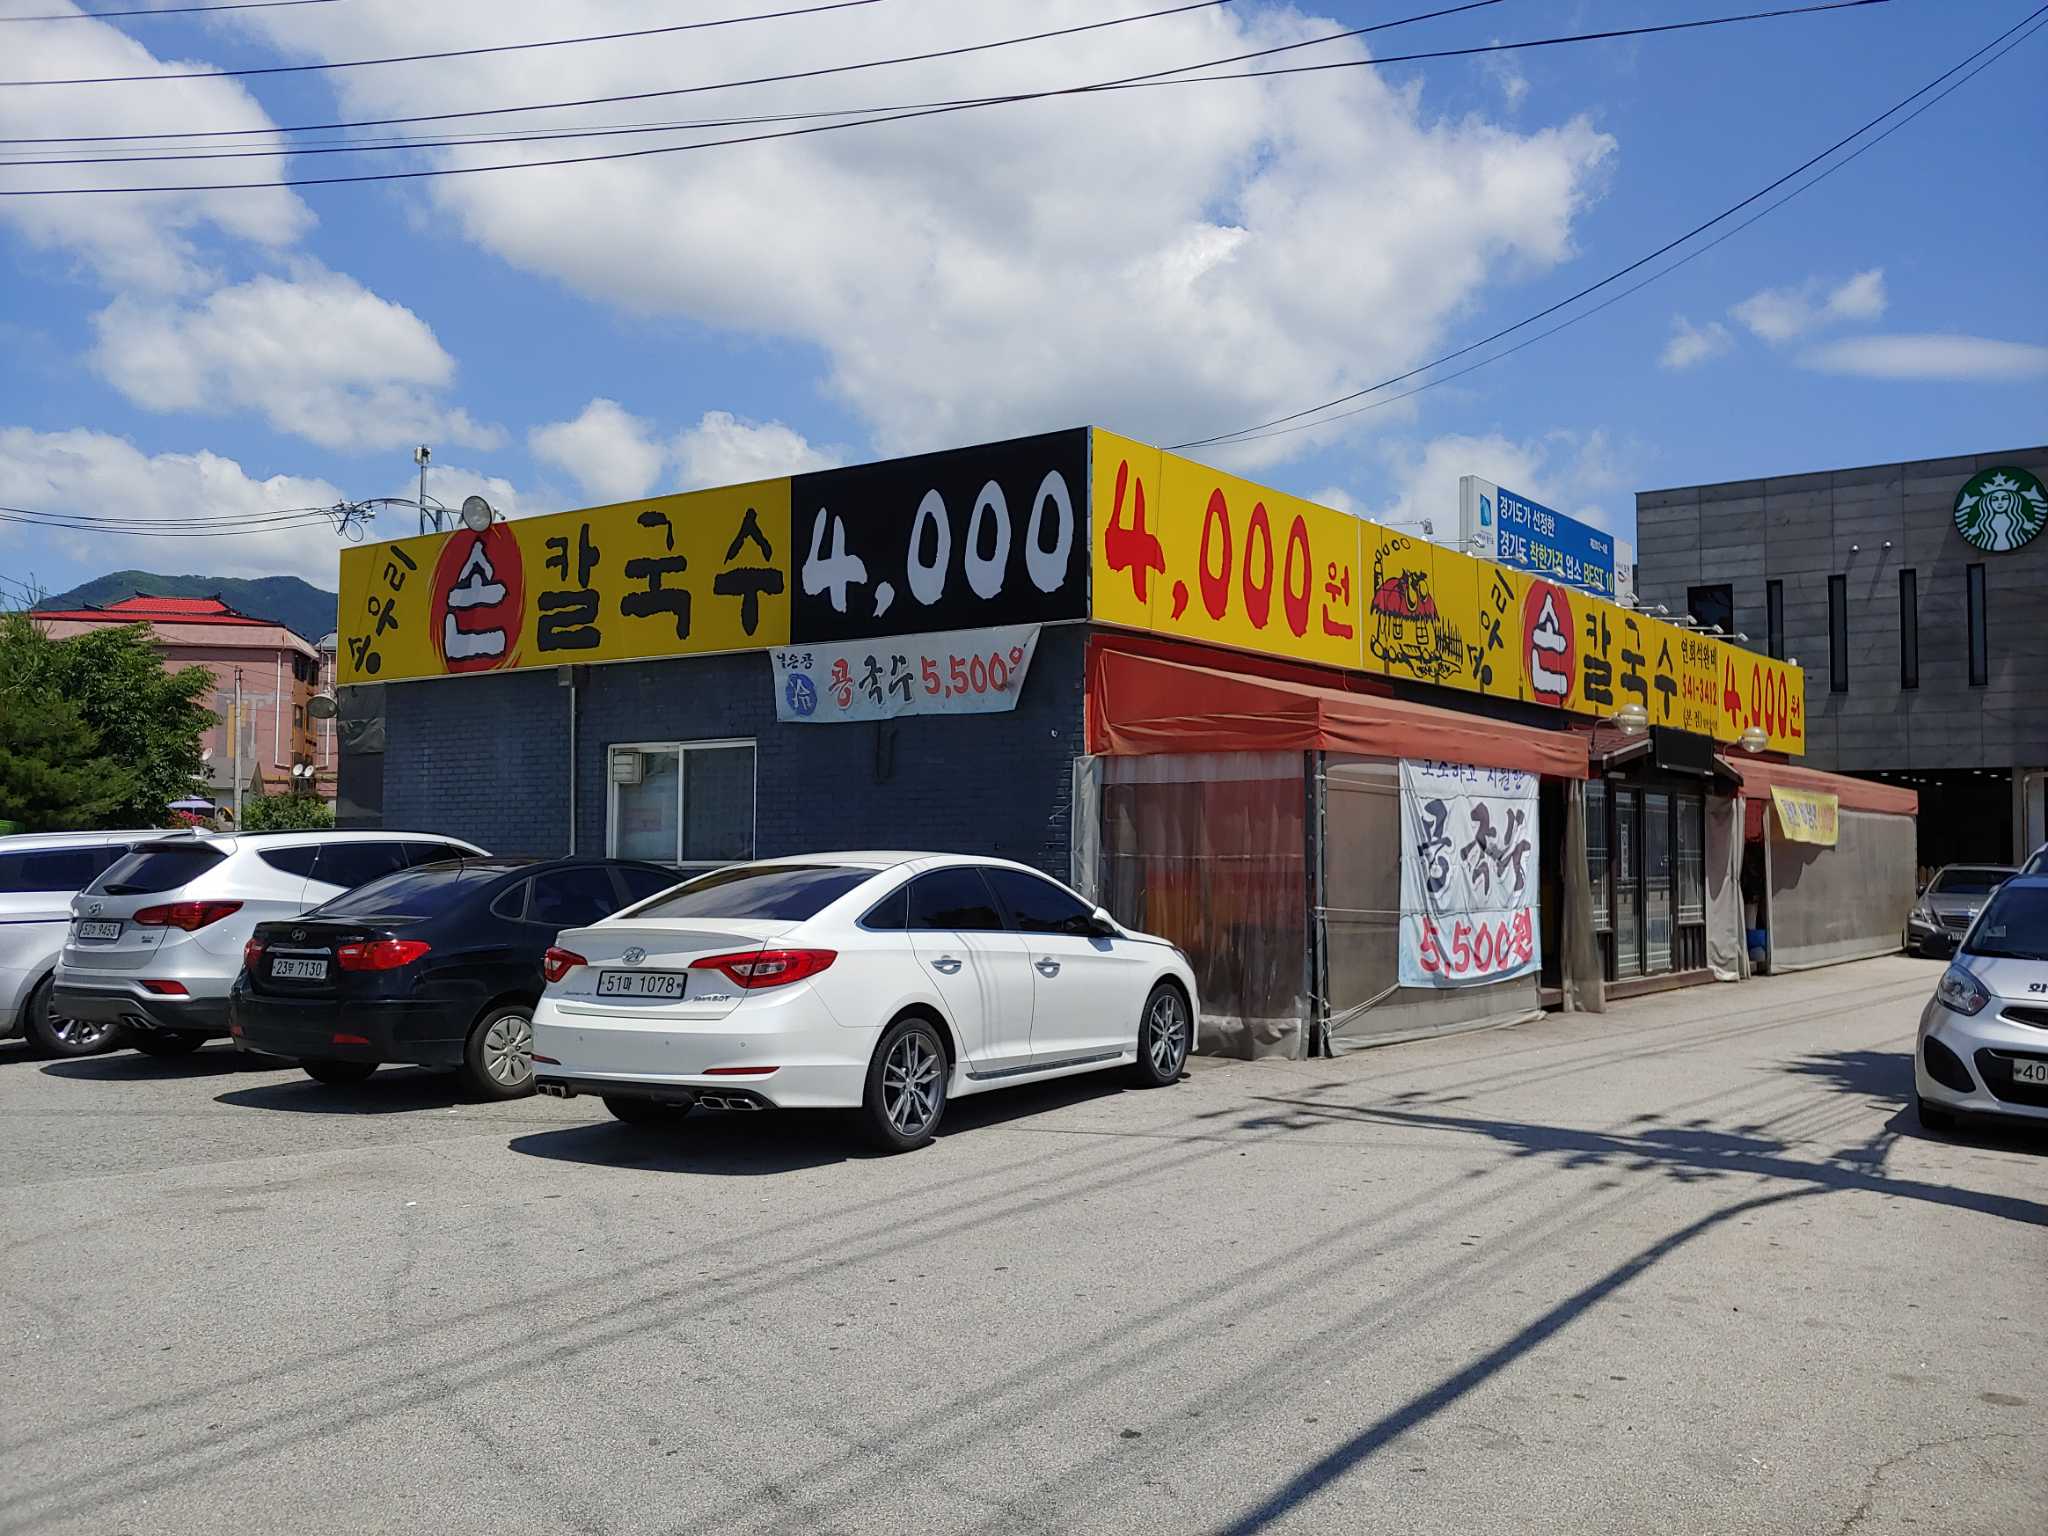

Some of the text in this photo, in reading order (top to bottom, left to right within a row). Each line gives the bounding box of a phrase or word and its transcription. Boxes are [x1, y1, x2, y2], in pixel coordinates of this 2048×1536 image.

[1500, 496, 1556, 537] 경기도가 선정한
[802, 470, 1075, 617] 4,000
[1500, 529, 1527, 562] 경기도
[1565, 554, 1583, 581] 업소
[1583, 562, 1605, 591] BEST
[1606, 571, 1613, 593] 10
[829, 655, 914, 708] 콩국수
[1683, 673, 1717, 706] 541-3412
[1421, 758, 1478, 784] 고소하고
[1418, 799, 1532, 896] 콩국수
[297, 961, 322, 977] 7130
[640, 976, 675, 994] 1078
[2022, 1064, 2048, 1081] 40
